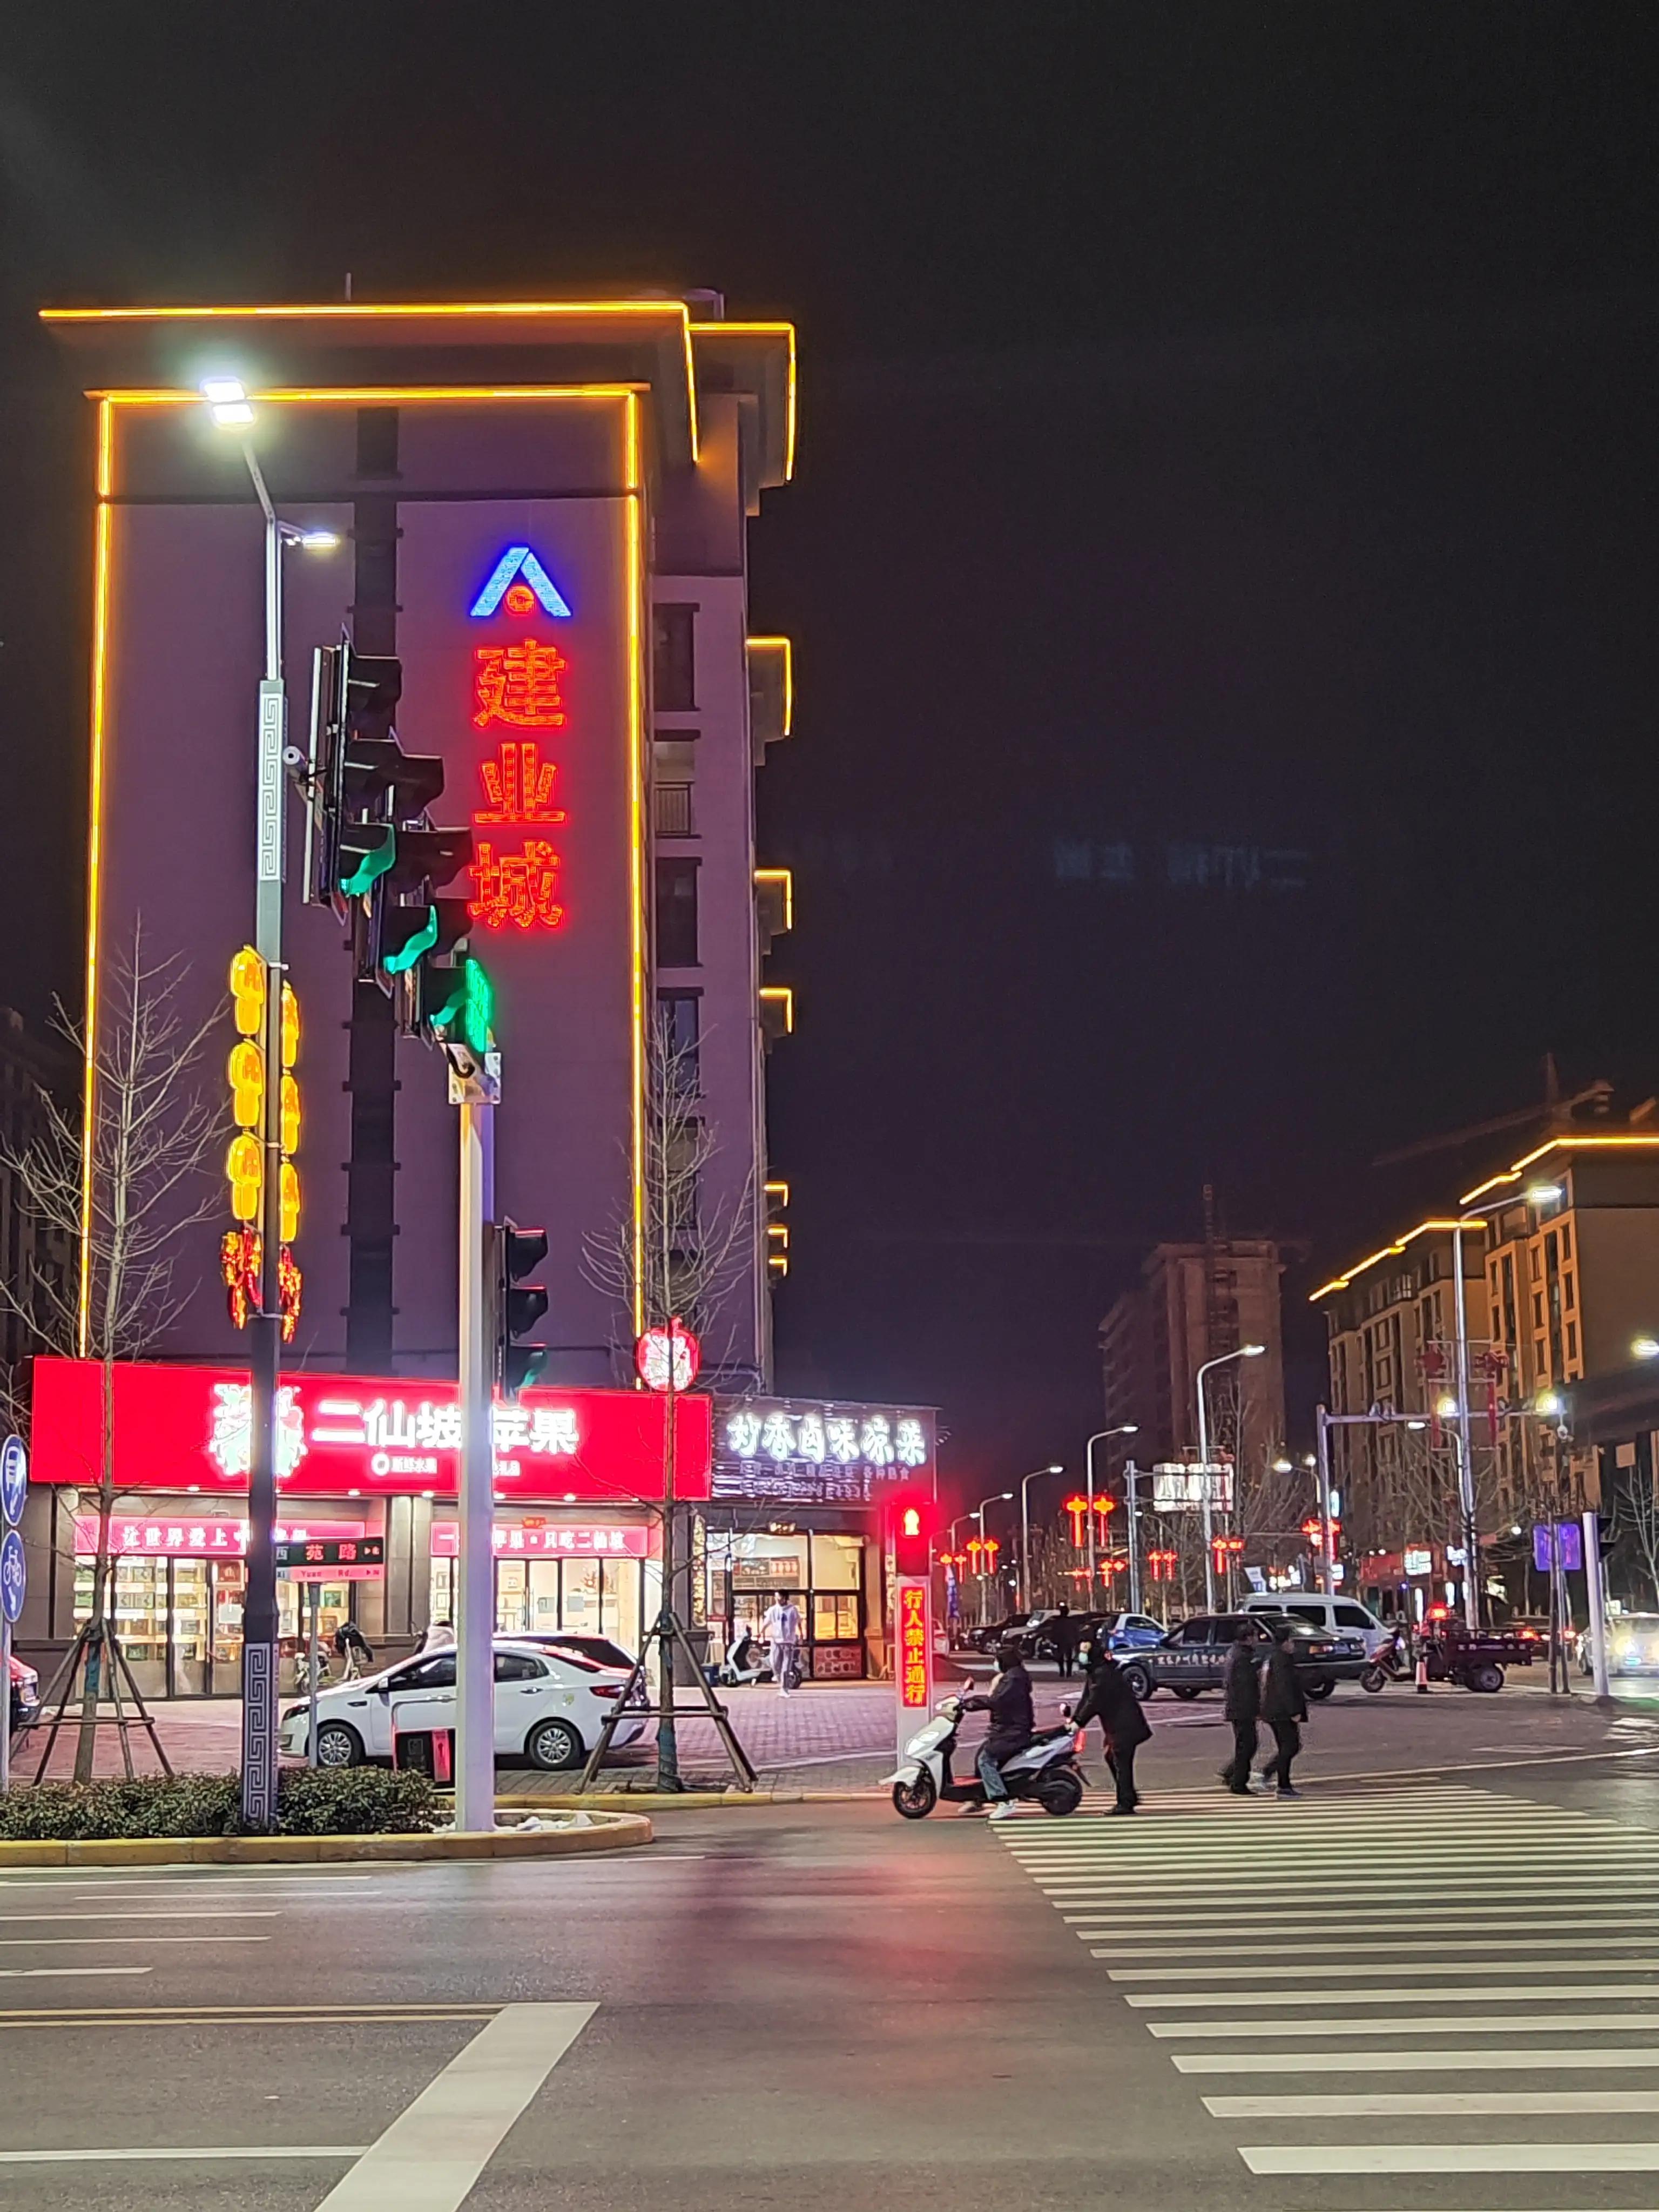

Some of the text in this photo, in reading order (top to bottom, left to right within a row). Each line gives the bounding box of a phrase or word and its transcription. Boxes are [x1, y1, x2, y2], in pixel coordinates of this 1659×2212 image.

[468, 639, 566, 929] 建业城
[312, 1398, 579, 1454] 二仙坡苹果
[276, 1543, 357, 1561] 西苑路
[903, 1589, 925, 1705] 行人禁止通行
